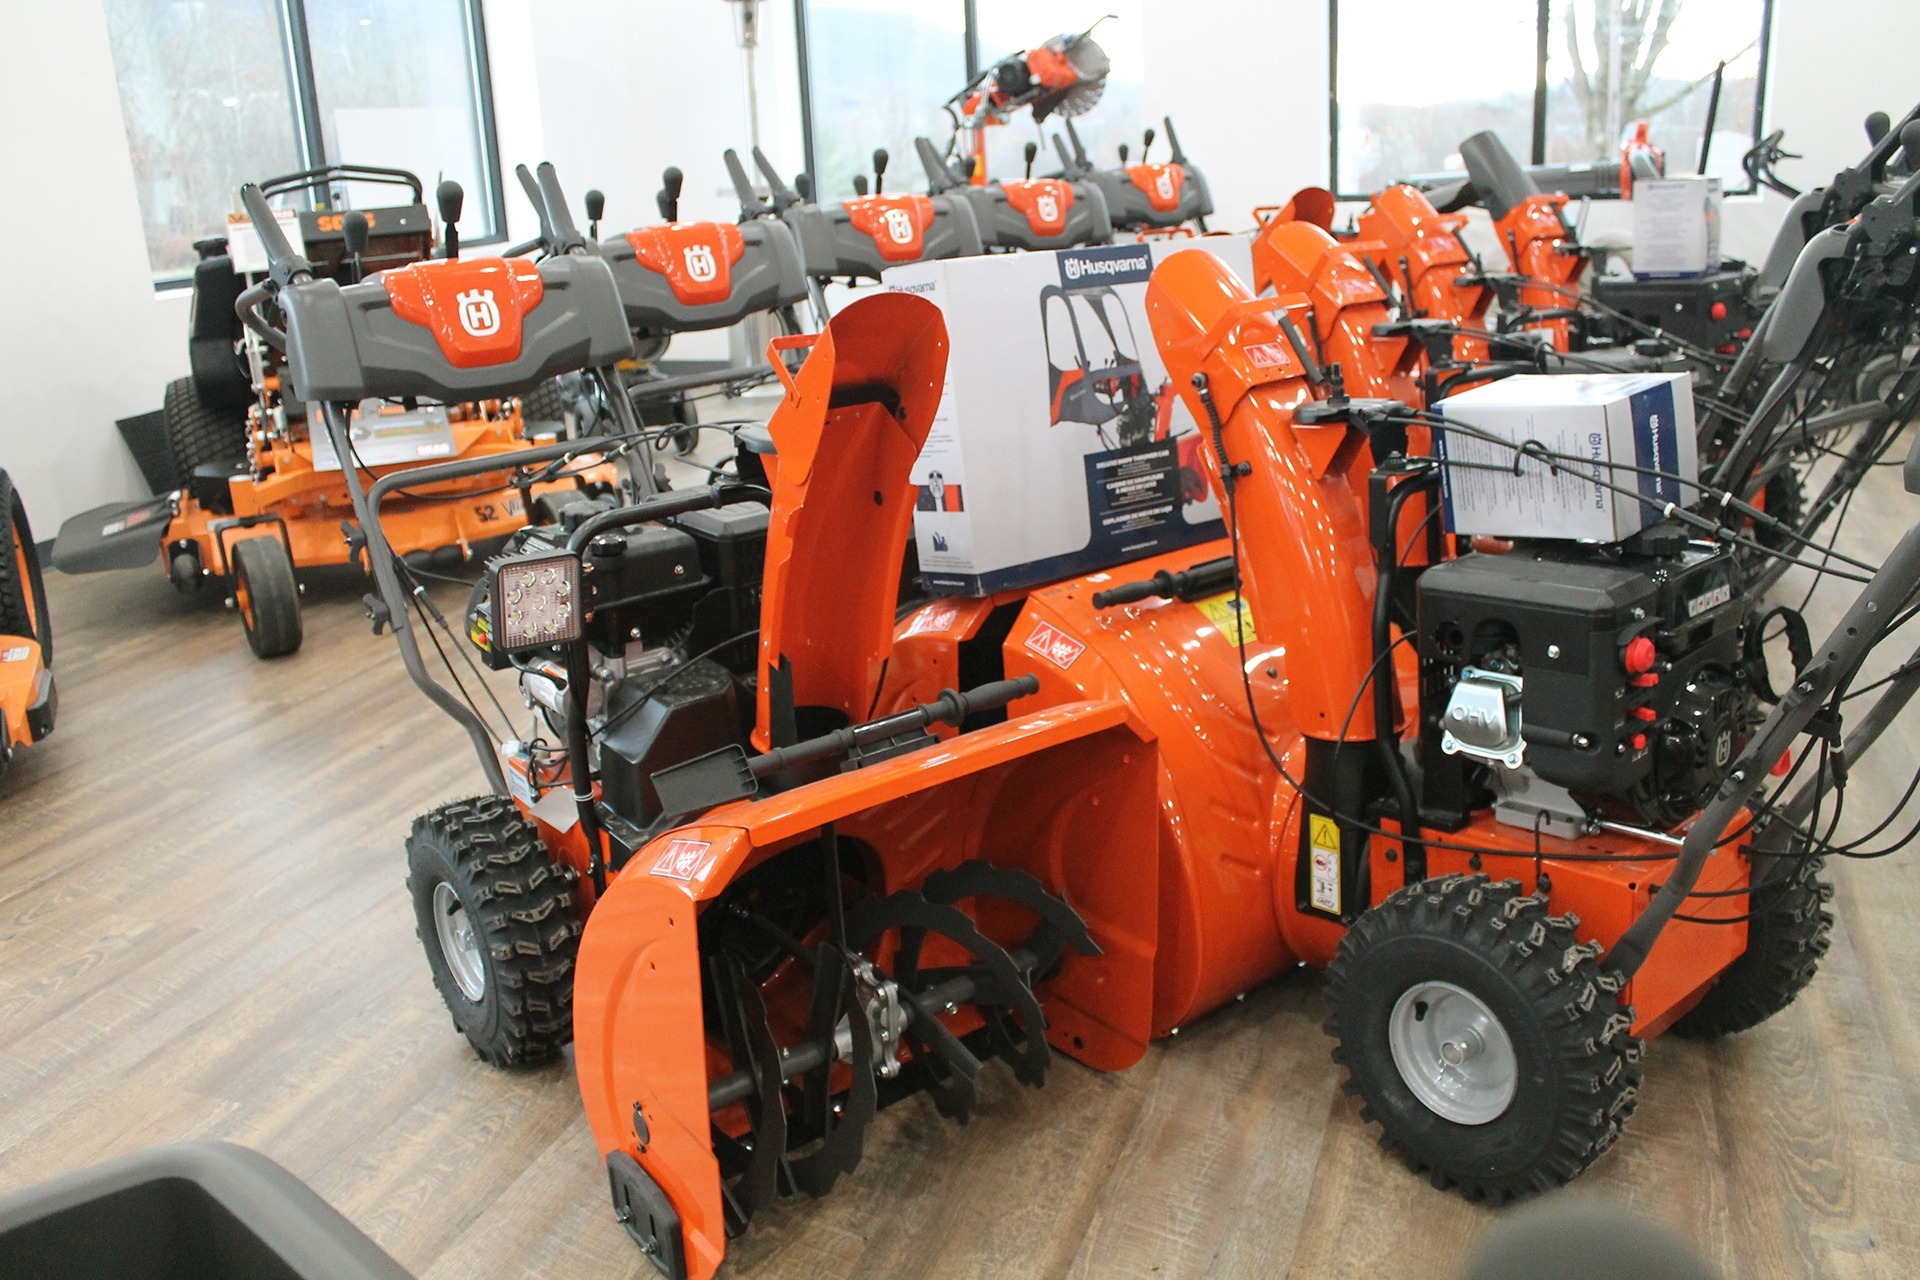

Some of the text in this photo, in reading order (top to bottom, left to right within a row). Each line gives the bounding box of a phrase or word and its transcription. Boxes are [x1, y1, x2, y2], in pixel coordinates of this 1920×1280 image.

[317, 211, 376, 232] SCG
[1080, 256, 1147, 275] Husqvarna
[1651, 428, 1661, 493] Husqvana
[474, 504, 499, 523] 52
[1451, 705, 1498, 729] OHV
